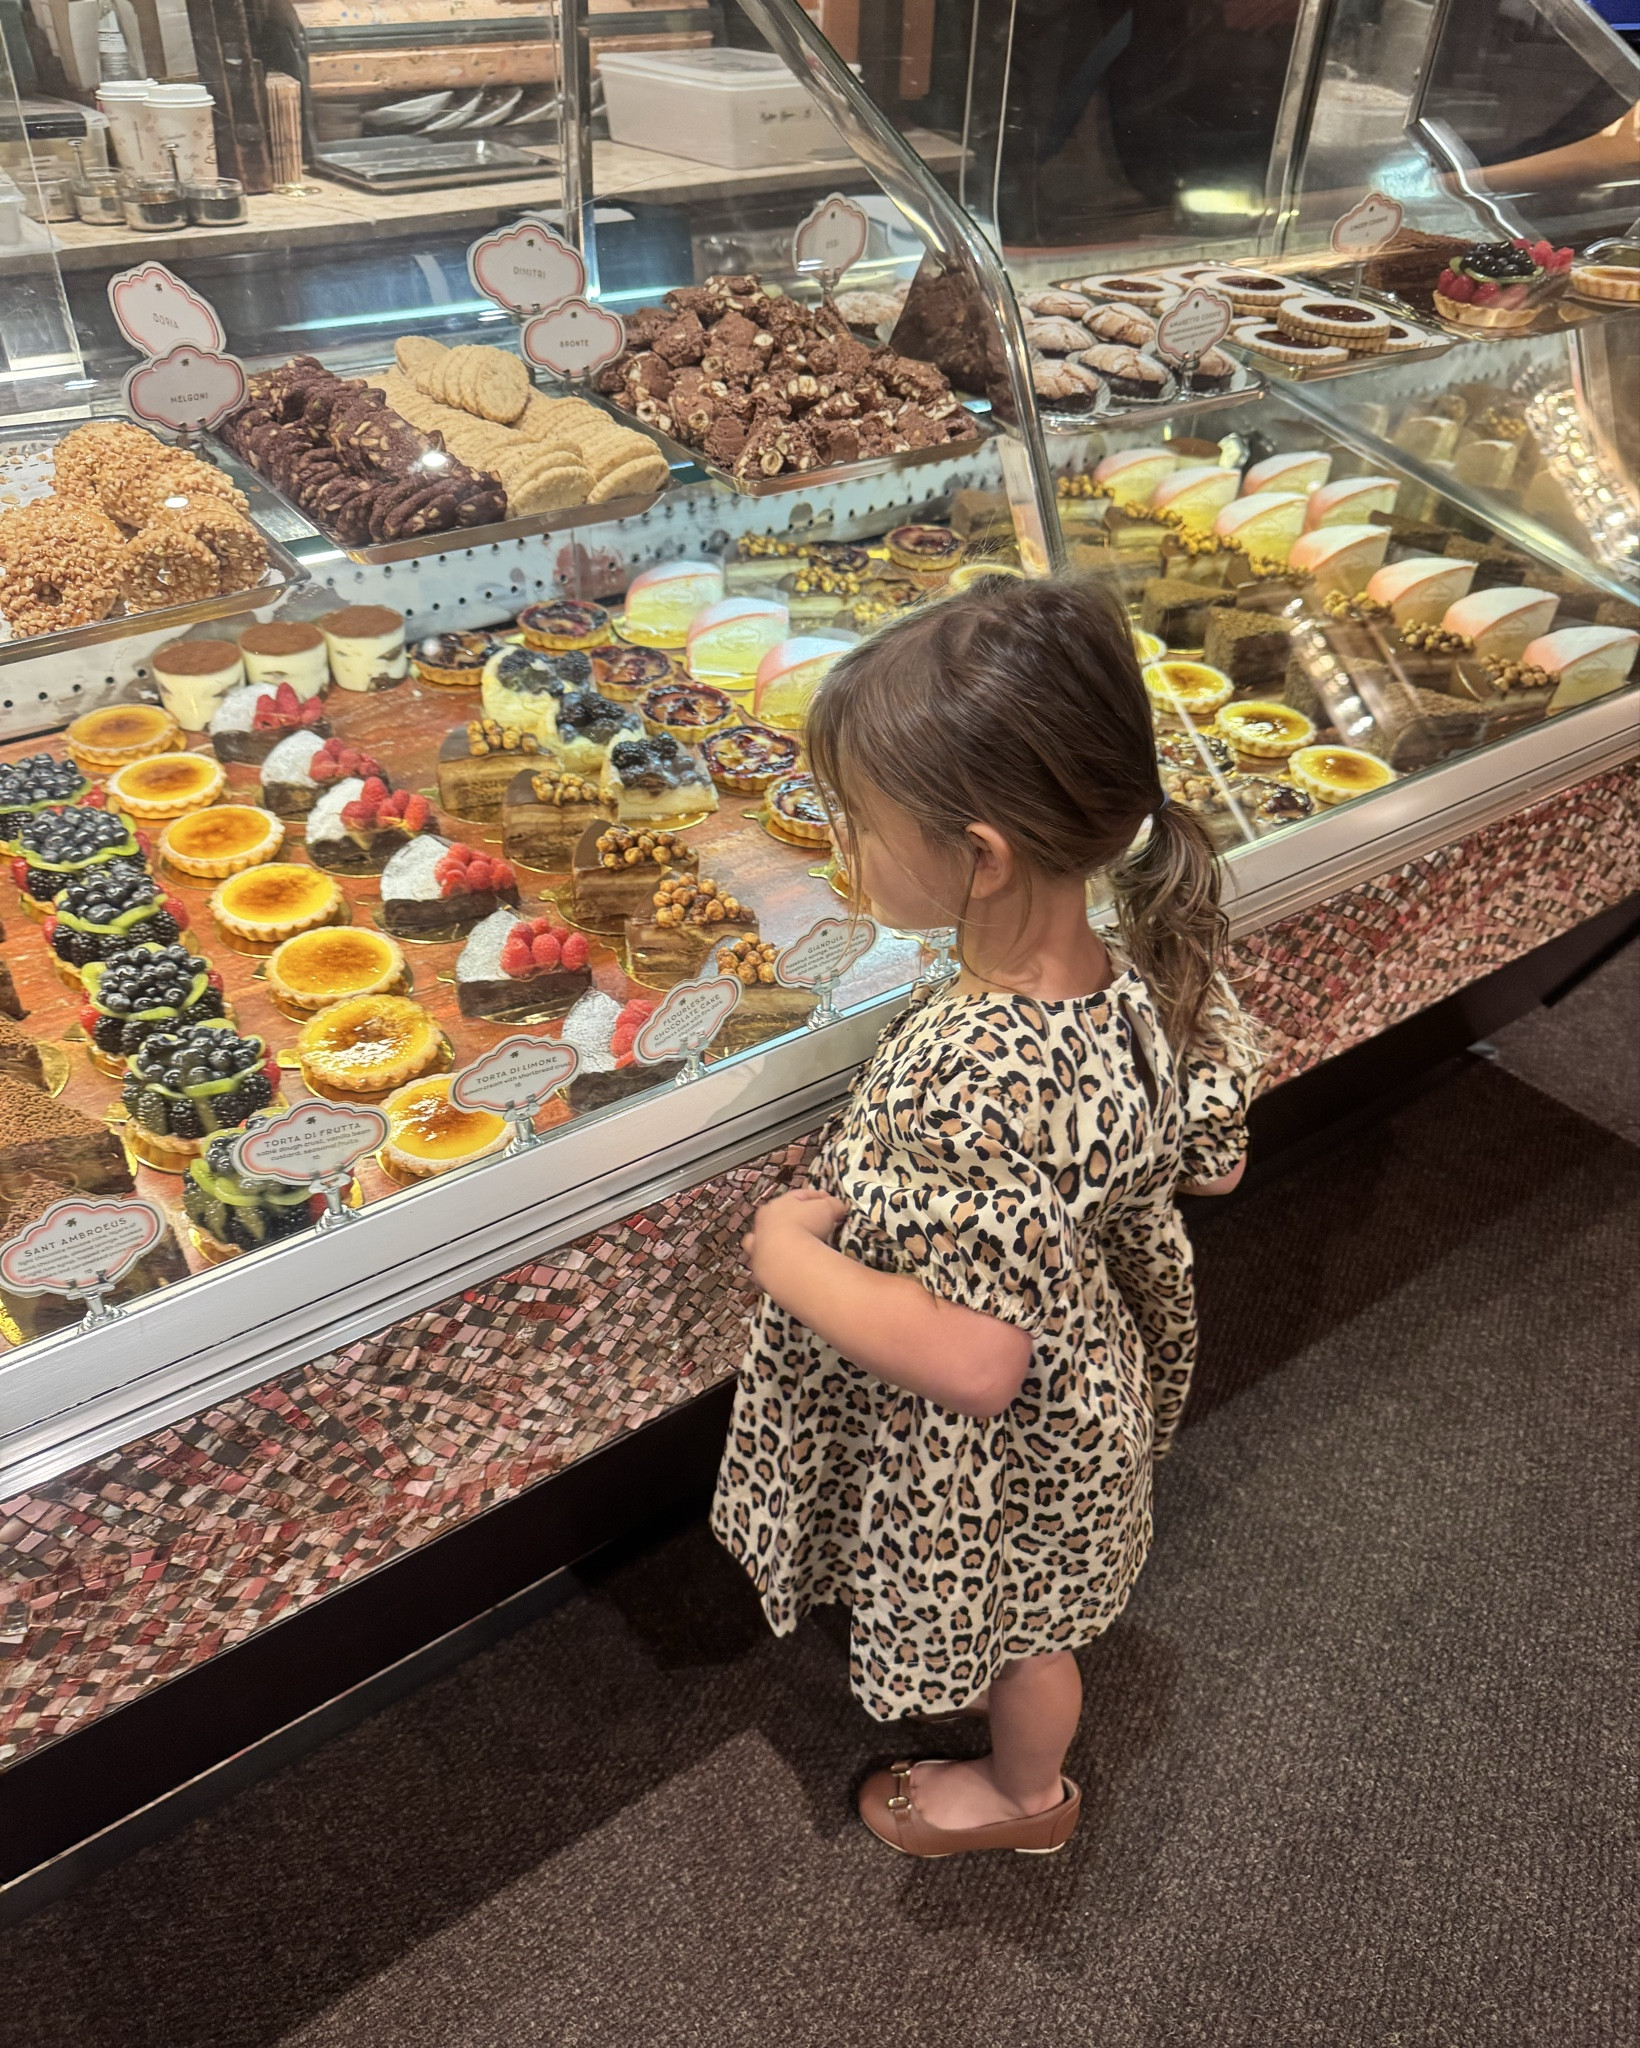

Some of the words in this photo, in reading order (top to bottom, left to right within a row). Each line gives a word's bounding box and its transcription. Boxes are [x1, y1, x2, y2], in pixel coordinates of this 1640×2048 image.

[513, 266, 546, 279] DIMITRI
[153, 313, 179, 329] DORIA
[560, 339, 589, 348] BRONTE
[654, 1009, 699, 1041] CHOCOLATE
[700, 994, 720, 1009] CAKE
[663, 996, 706, 1026] FLOURLESS
[476, 1071, 506, 1084] TORTA
[509, 1066, 520, 1074] DI
[522, 1056, 557, 1071] LIMONE
[264, 1134, 300, 1148] TORTA
[304, 1131, 316, 1139] DI
[319, 1122, 360, 1136] FRUTTA
[24, 1242, 55, 1257] SANT
[61, 1218, 127, 1245] AMBROEUS
